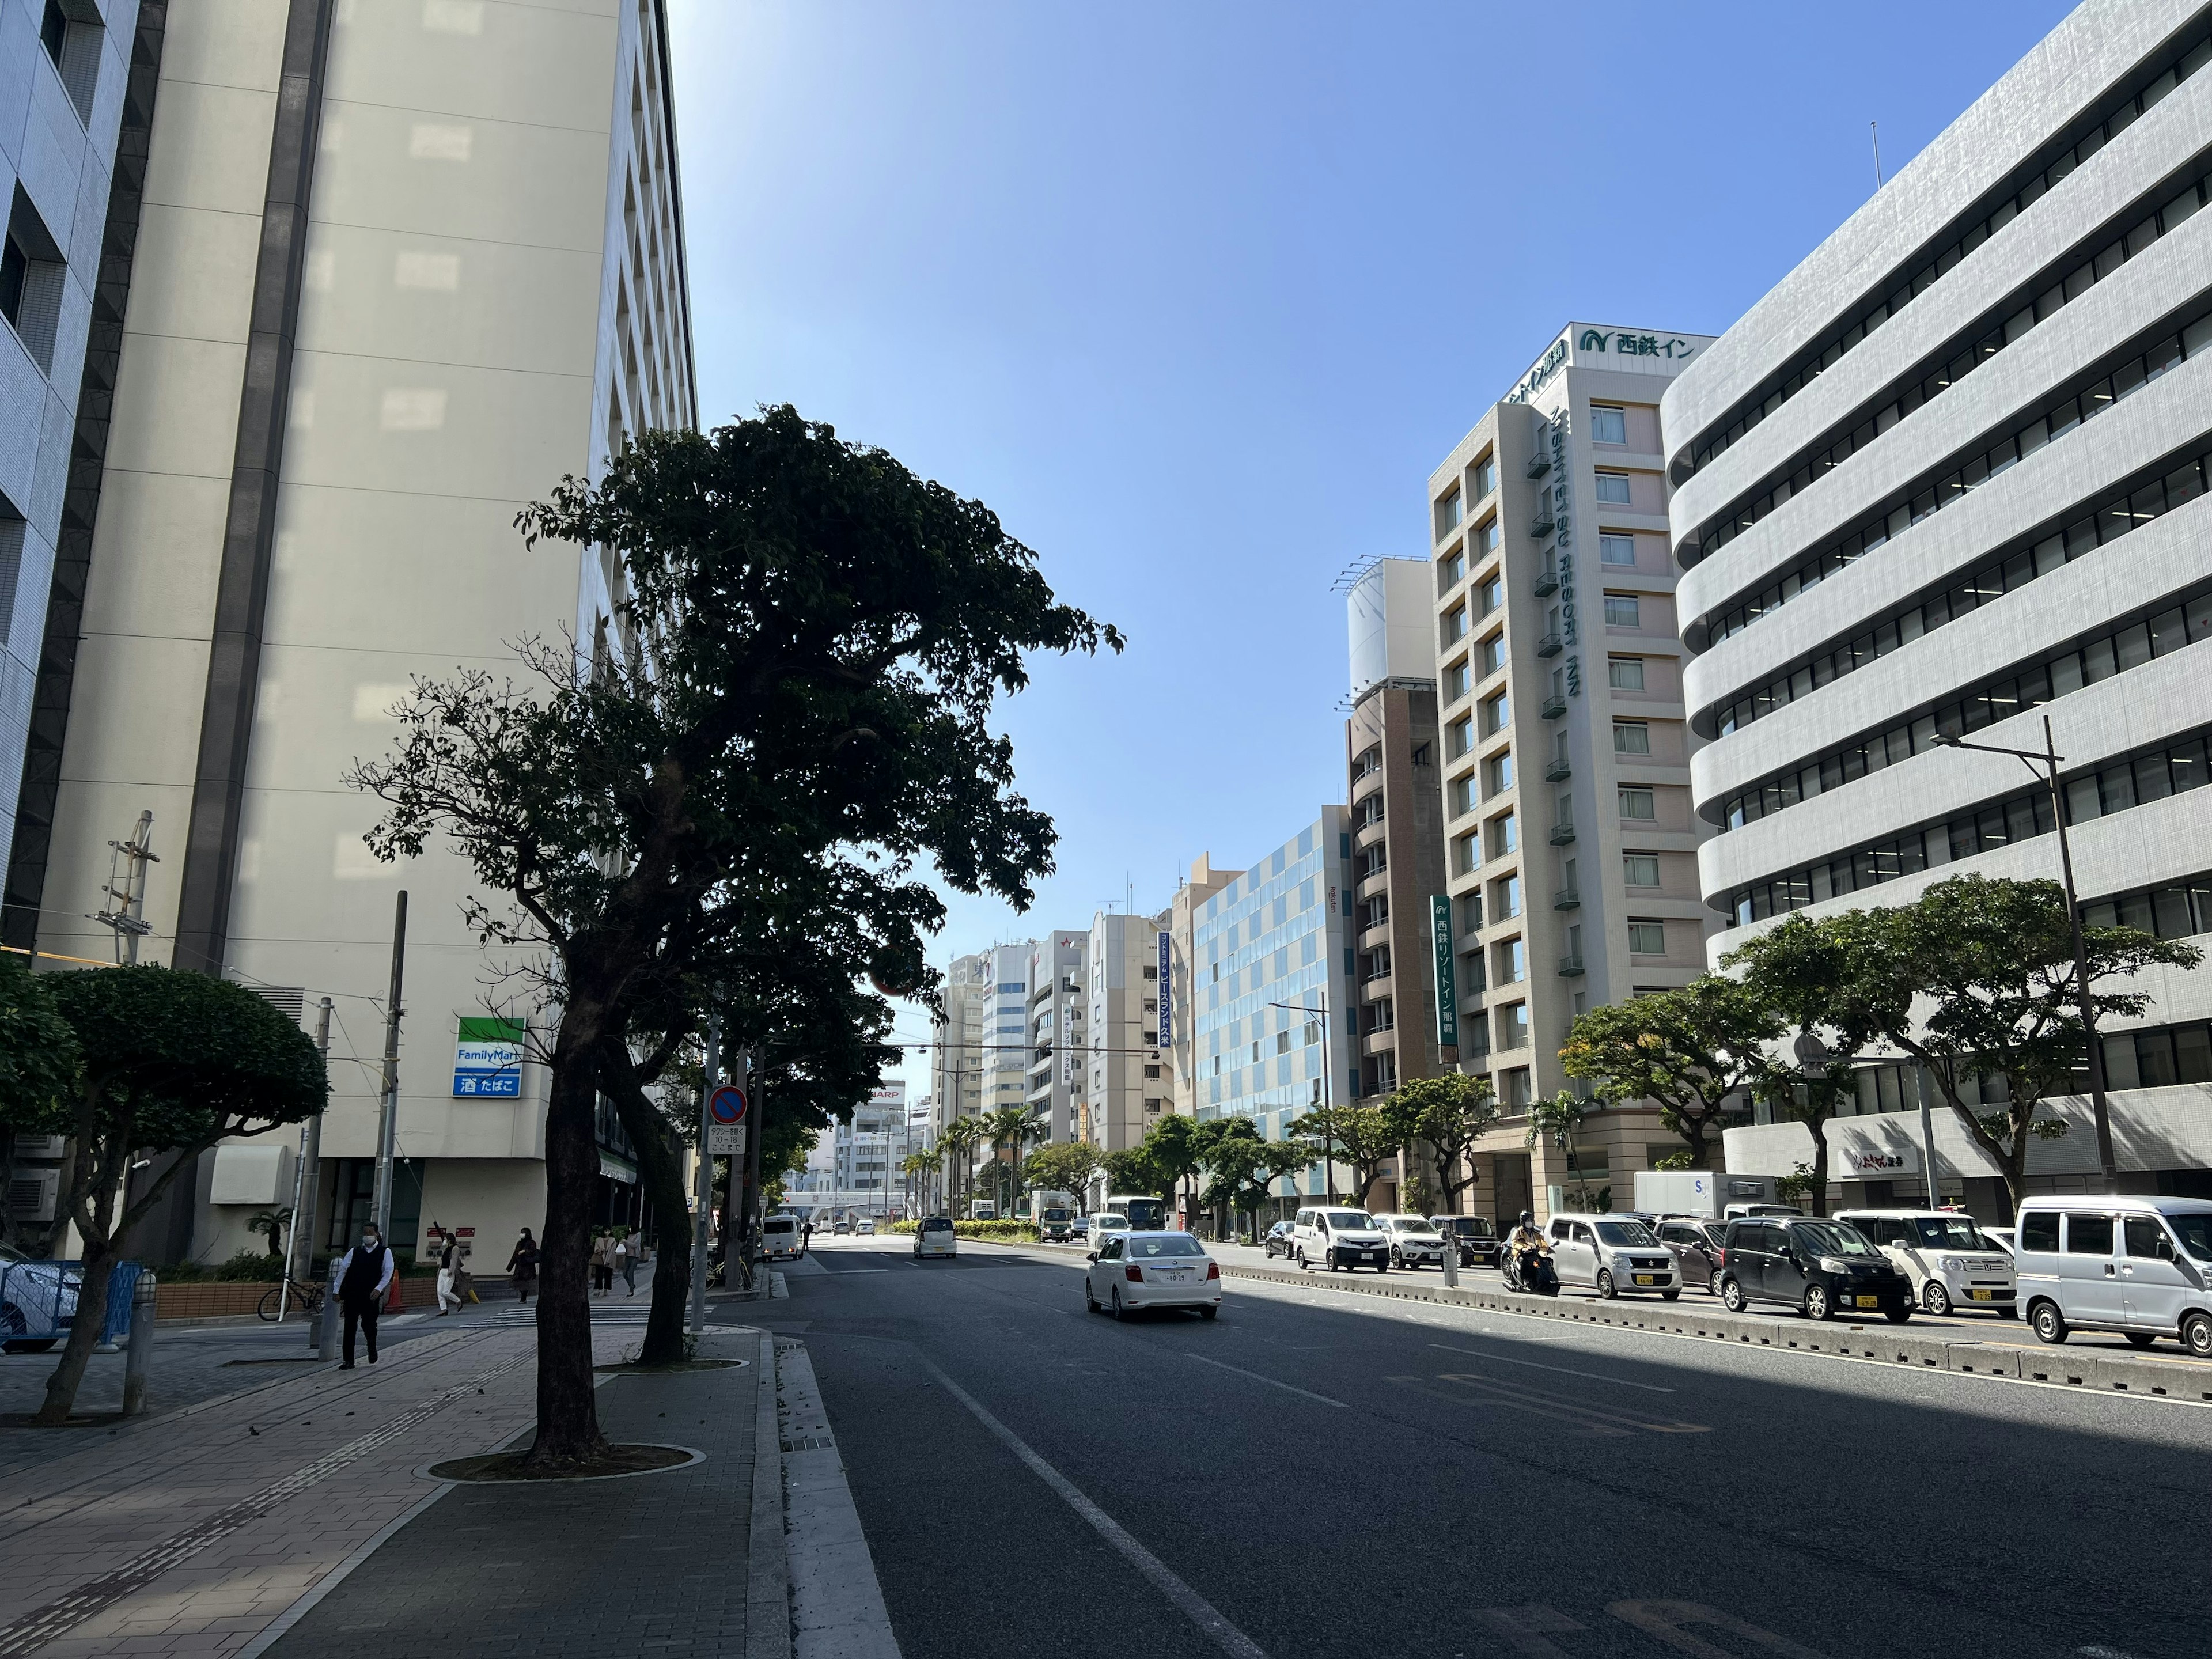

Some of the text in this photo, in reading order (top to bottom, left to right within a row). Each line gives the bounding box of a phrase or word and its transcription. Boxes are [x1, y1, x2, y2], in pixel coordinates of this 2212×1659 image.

[1616, 333, 1695, 359] 西鉄イン
[1437, 920, 1453, 1034] 西鉄リゾートイン那覇
[460, 1078, 513, 1093] 酒 たばこ
